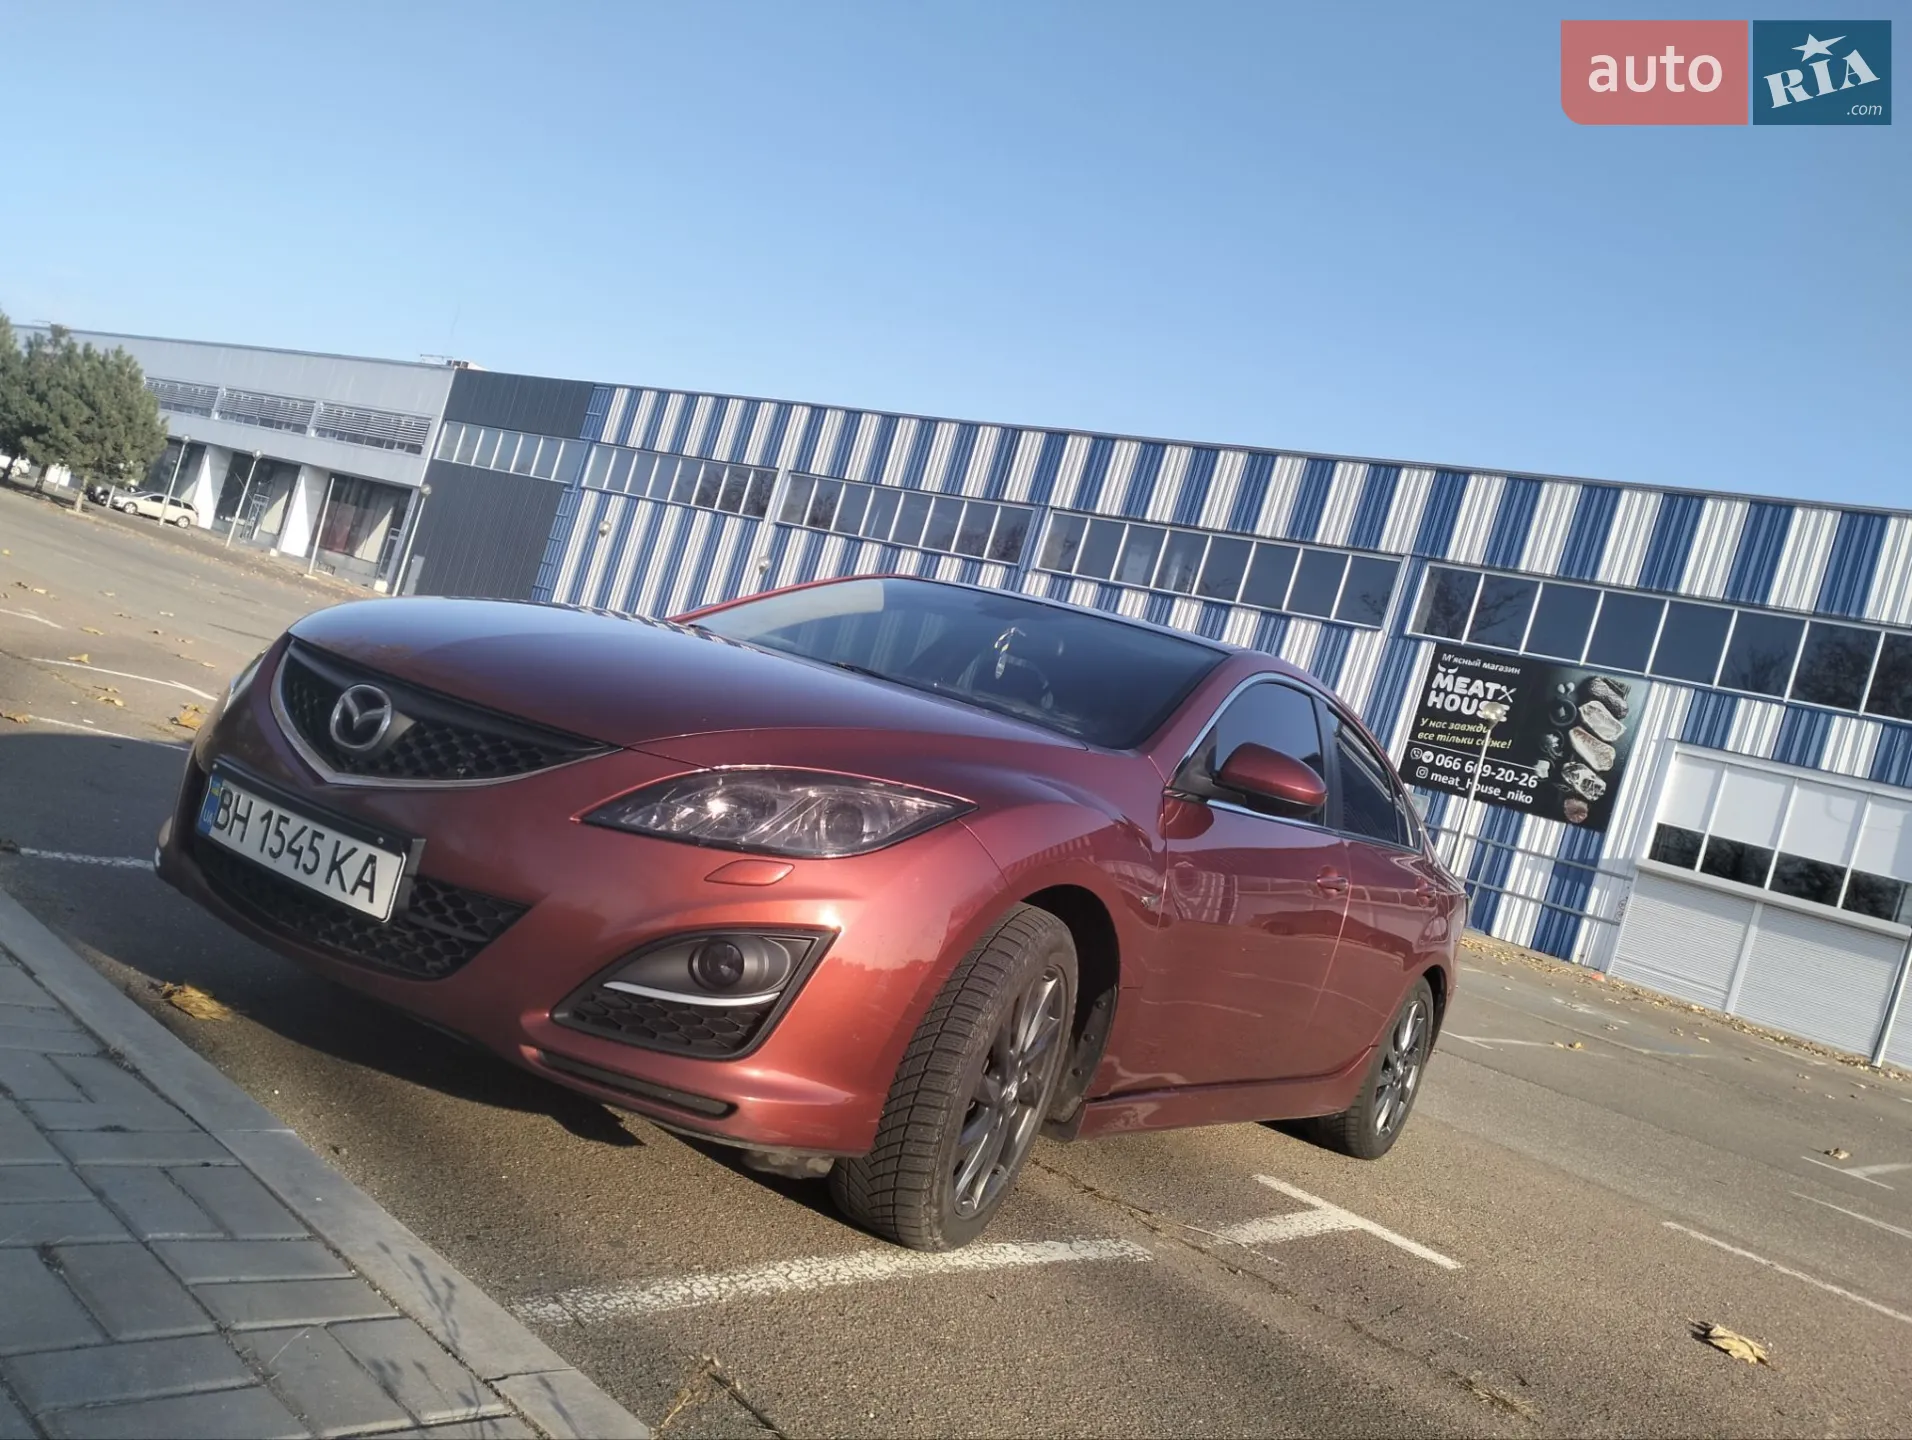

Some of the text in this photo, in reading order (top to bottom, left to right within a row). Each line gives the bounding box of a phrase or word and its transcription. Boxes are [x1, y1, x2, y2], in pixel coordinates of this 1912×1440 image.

[1483, 662, 1521, 674] магазин
[1432, 672, 1501, 700] MEAT
[1420, 718, 1428, 726] У
[1429, 719, 1447, 729] нас
[1418, 732, 1434, 740] все
[1437, 733, 1474, 744] тільки
[1435, 754, 1462, 770] 066
[203, 788, 377, 903] UA BH 1545 KA
